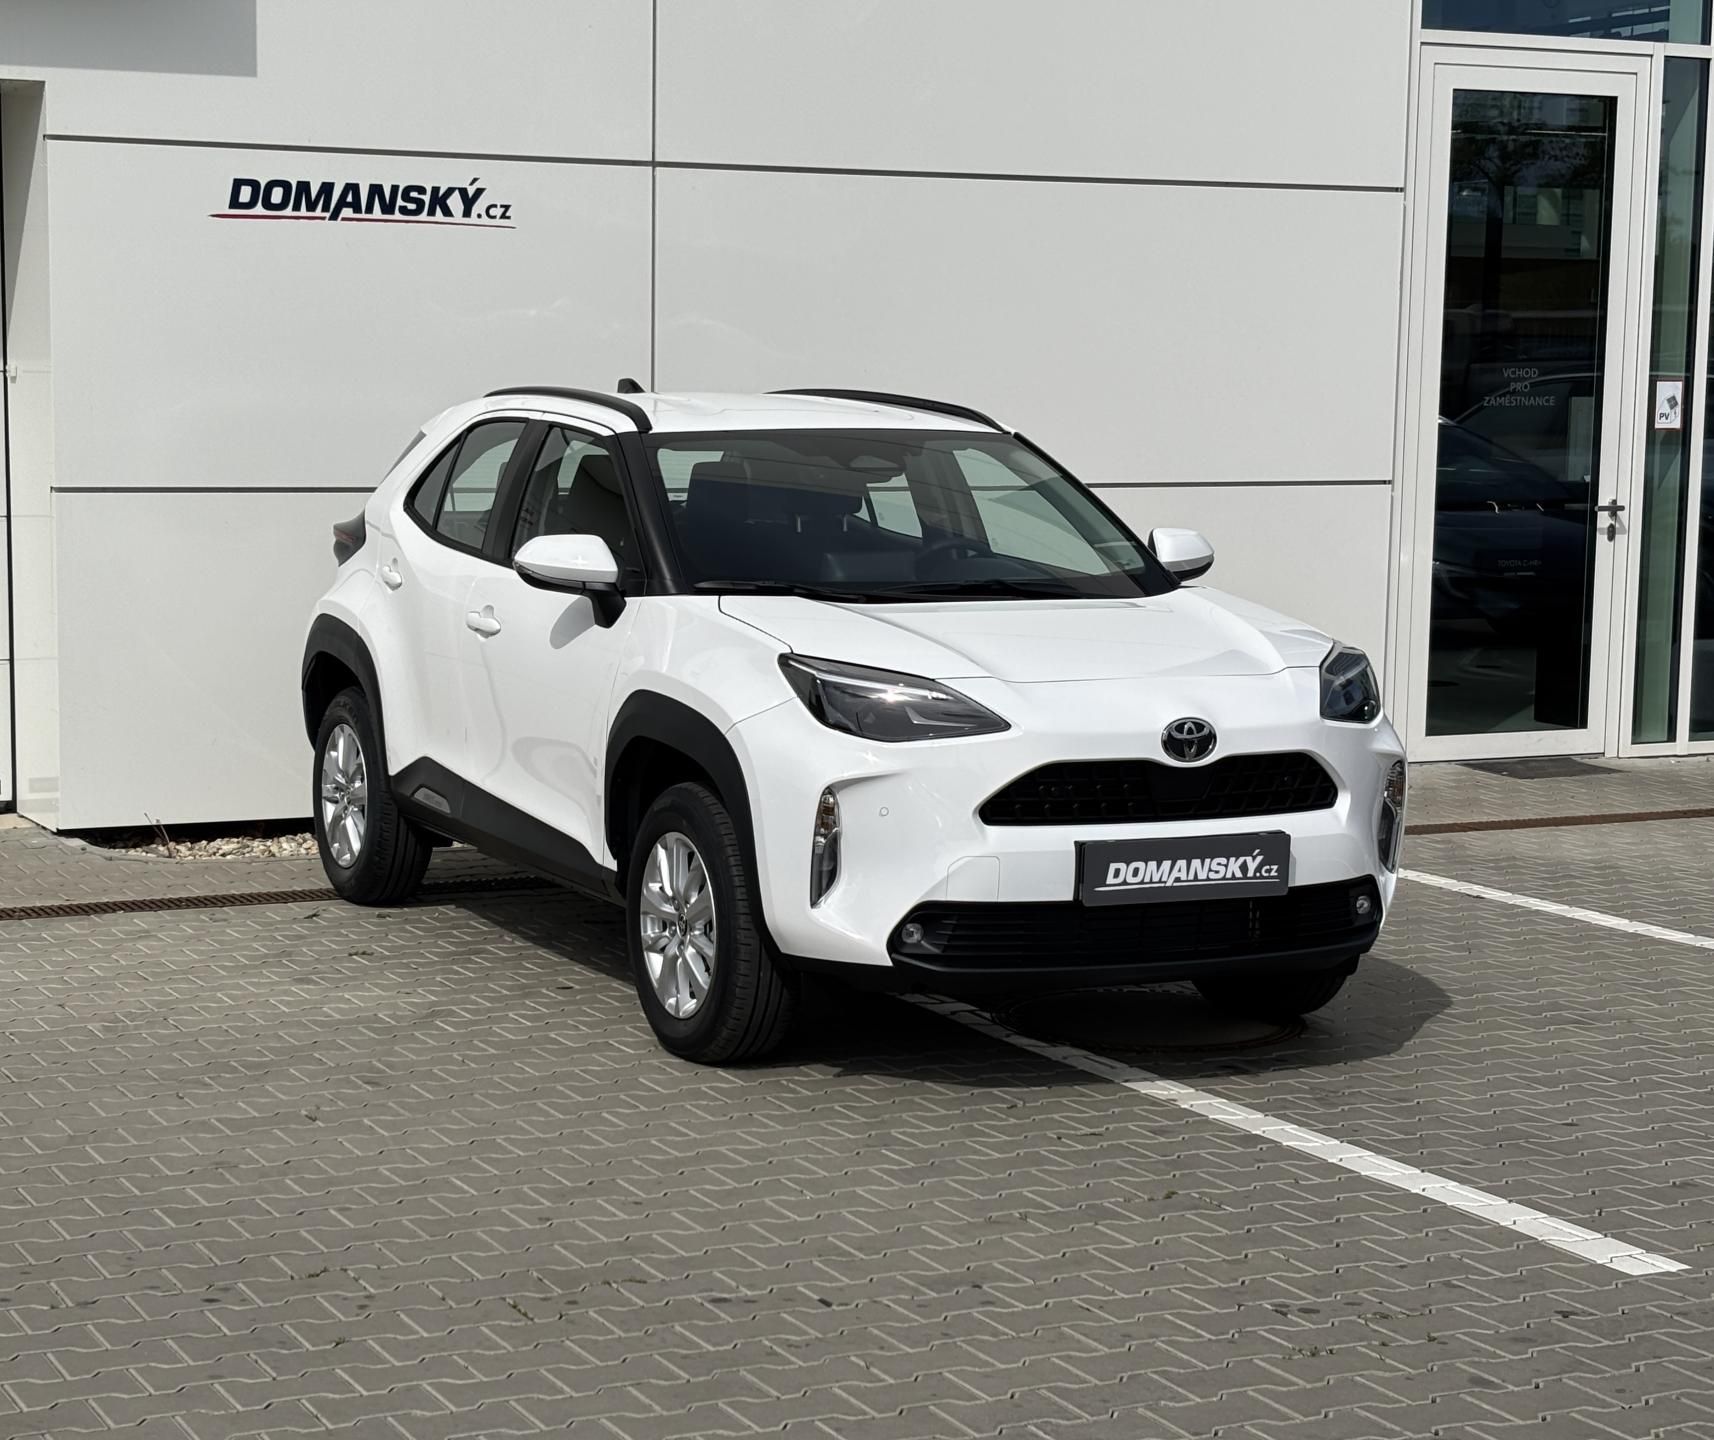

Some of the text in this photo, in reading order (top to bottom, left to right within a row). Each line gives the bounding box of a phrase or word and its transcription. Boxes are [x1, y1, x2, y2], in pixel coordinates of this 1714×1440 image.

[1502, 367, 1538, 378] VCHOD
[1510, 382, 1530, 392] PRO
[1659, 412, 1670, 421] PV
